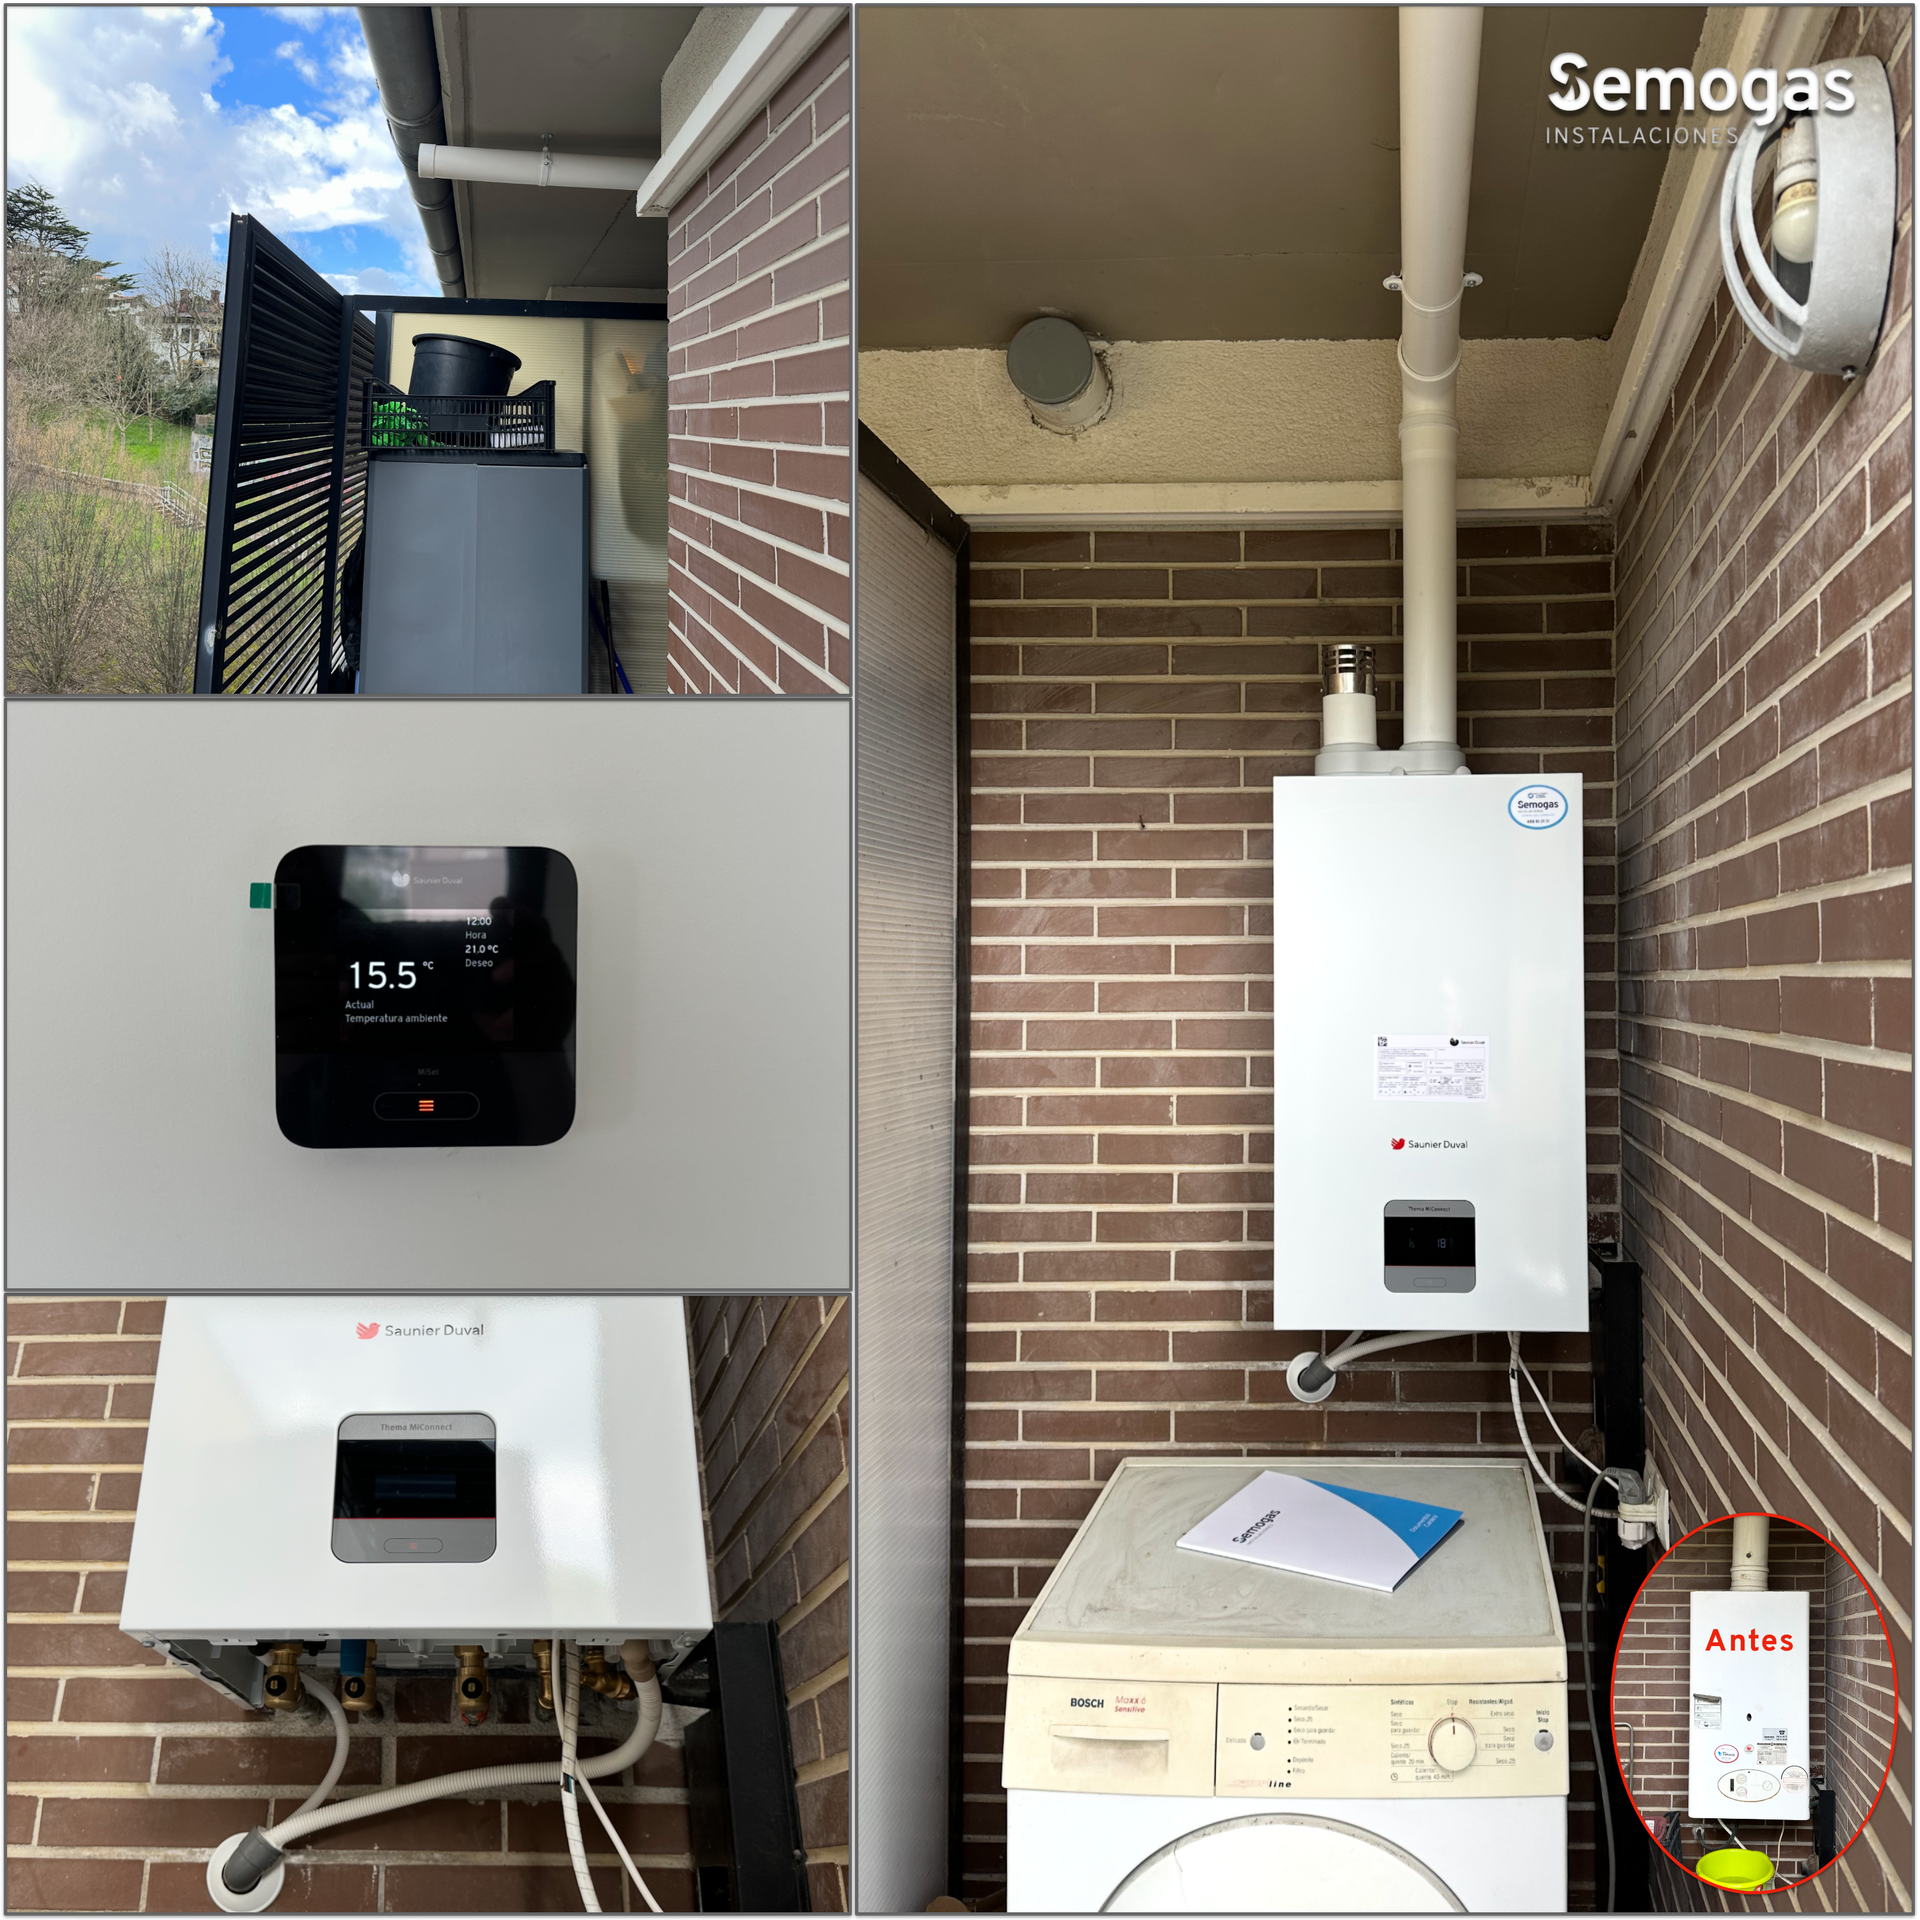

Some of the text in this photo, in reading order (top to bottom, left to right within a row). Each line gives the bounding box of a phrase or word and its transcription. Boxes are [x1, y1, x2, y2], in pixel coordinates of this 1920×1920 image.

[1517, 800, 1559, 810] Semogas
[466, 916, 492, 926] 12:00
[465, 931, 487, 939] Hora
[465, 958, 493, 967] Deseo
[350, 961, 417, 989] 15.5
[345, 1000, 374, 1009] Actual
[345, 1013, 448, 1024] Temperatura ambiente
[1408, 1140, 1468, 1149] Saunier Duval
[385, 1324, 484, 1337] Saunier Duval
[381, 1423, 453, 1432] Thema MiConnect
[1232, 1510, 1281, 1543] Semogas
[1070, 1697, 1104, 1708] BOSCH
[1115, 1696, 1147, 1705] Maxx 6
[1114, 1705, 1146, 1713] Sensitive
